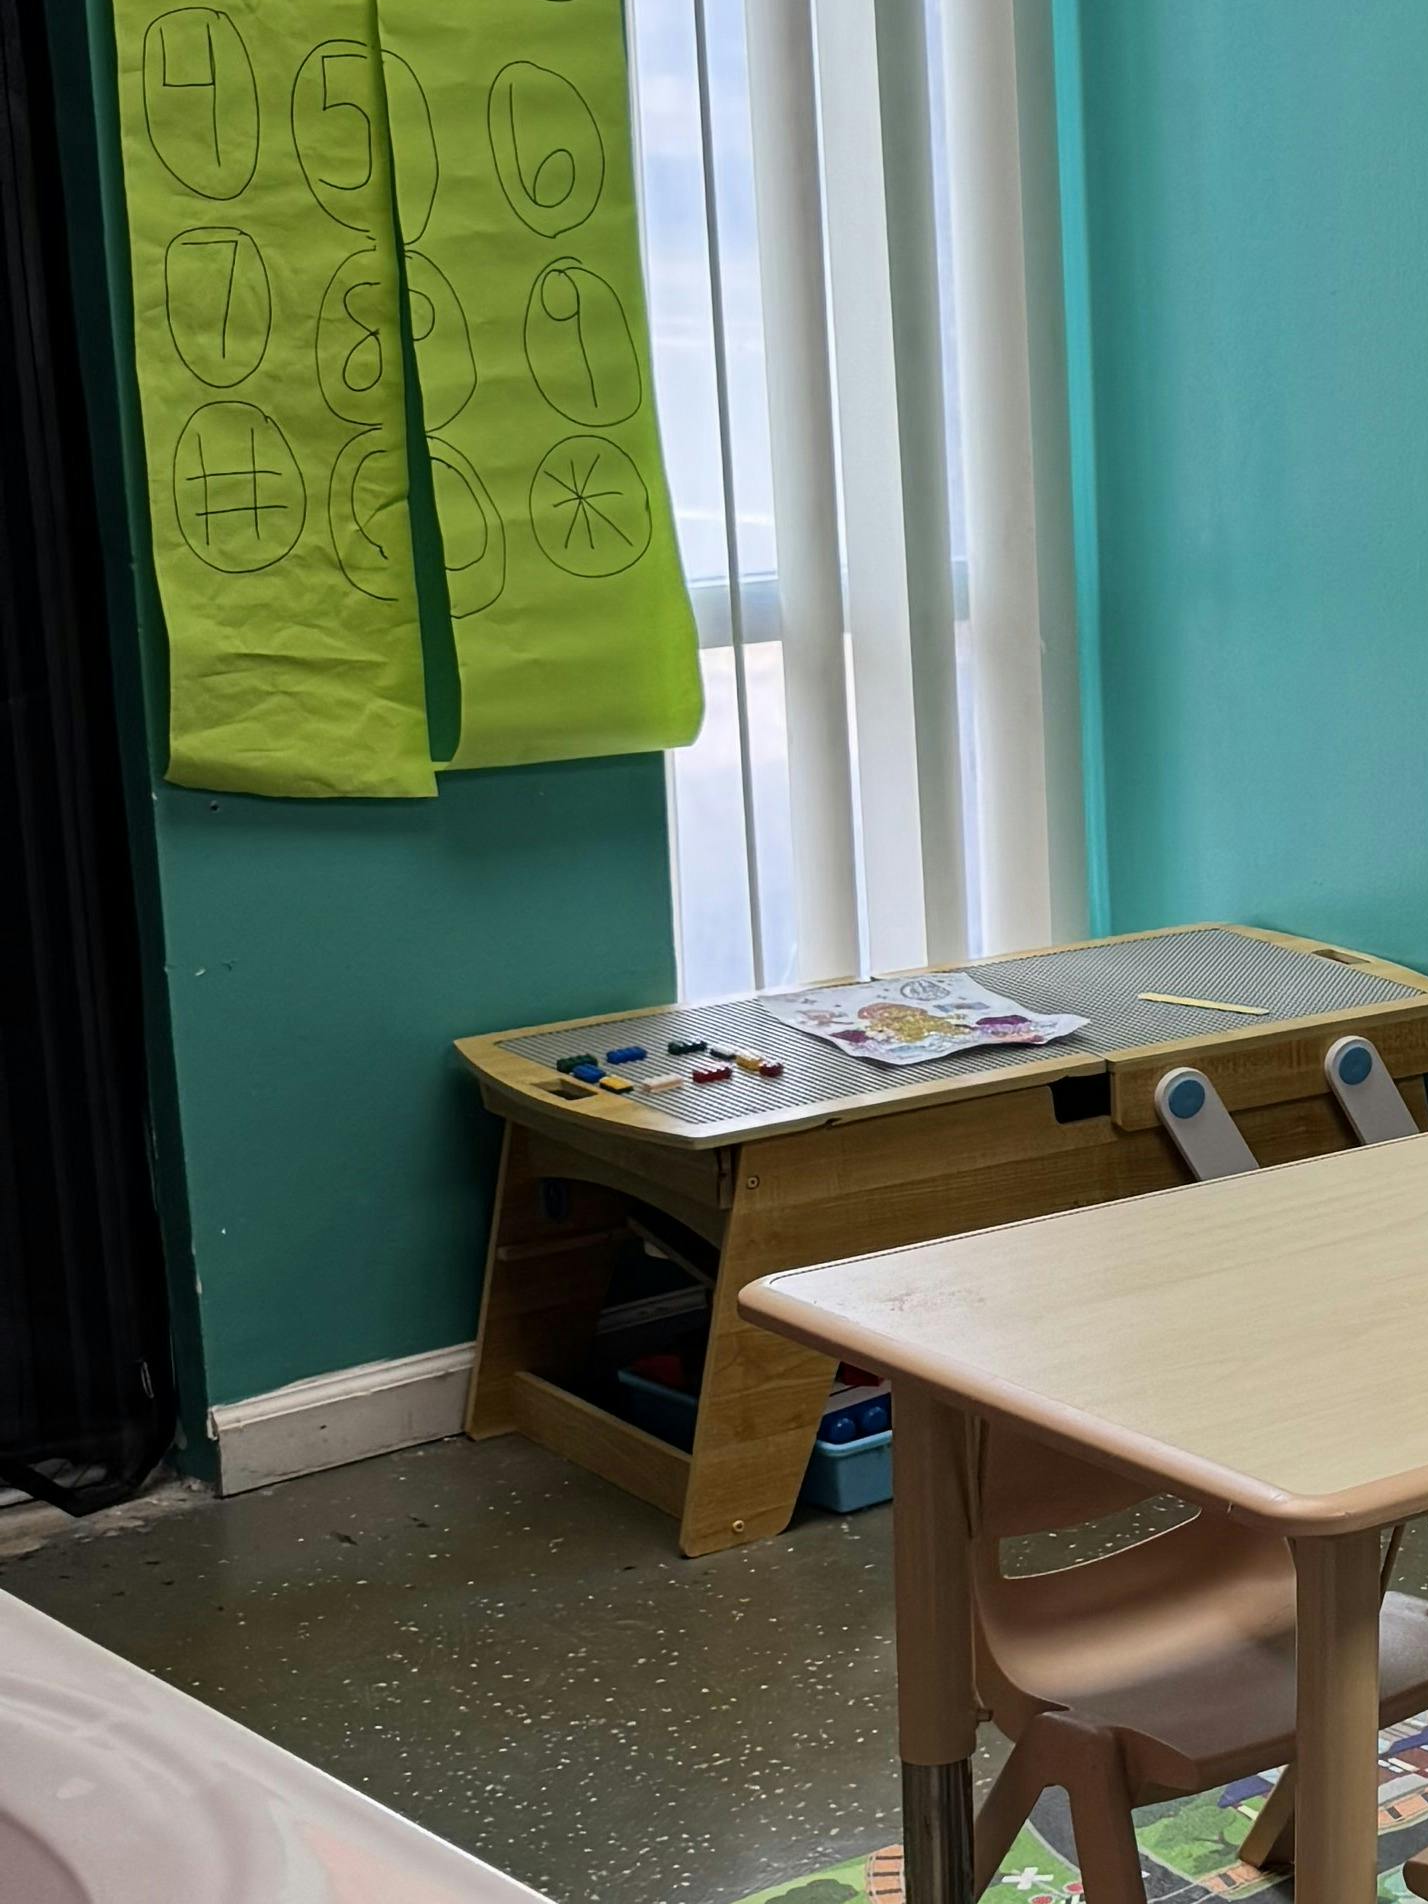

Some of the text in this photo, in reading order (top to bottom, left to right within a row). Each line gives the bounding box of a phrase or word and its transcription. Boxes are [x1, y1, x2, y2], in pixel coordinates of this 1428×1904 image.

[160, 23, 575, 208] 4 5 6
[181, 239, 239, 360] 7
[540, 268, 598, 409] 9
